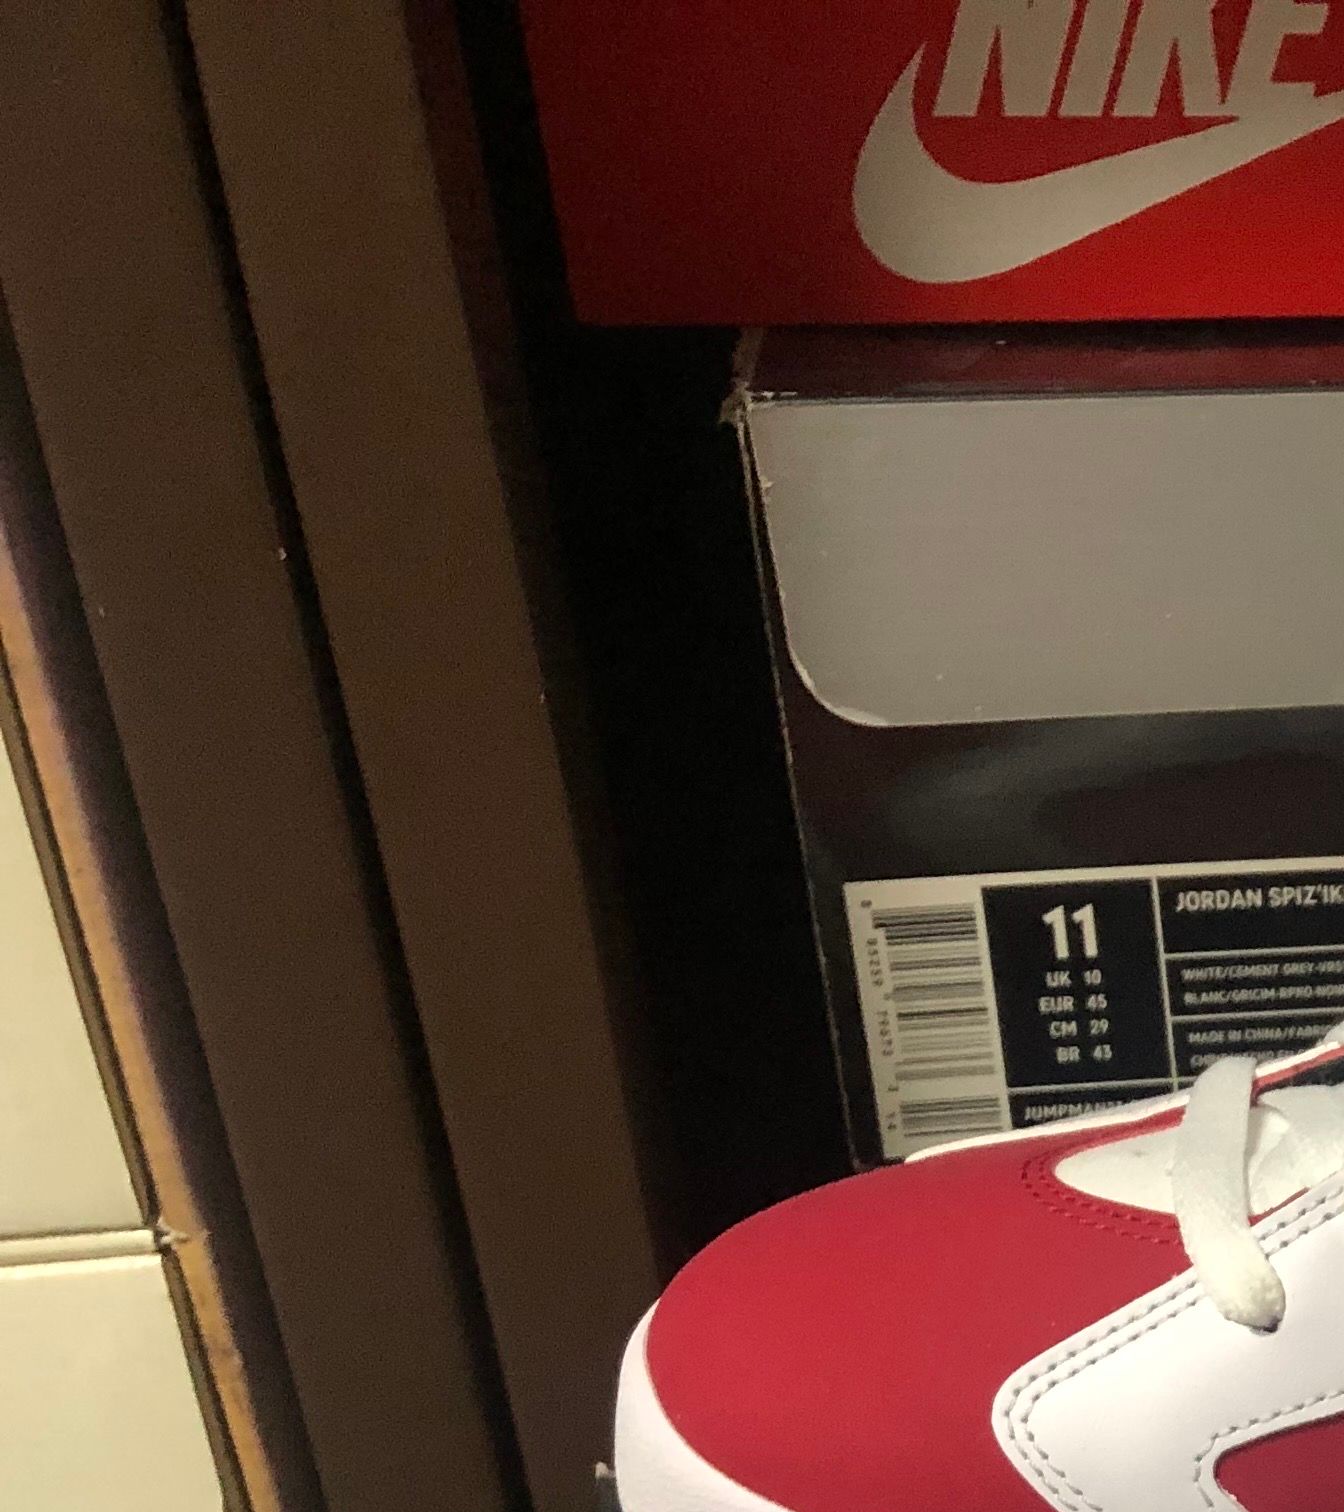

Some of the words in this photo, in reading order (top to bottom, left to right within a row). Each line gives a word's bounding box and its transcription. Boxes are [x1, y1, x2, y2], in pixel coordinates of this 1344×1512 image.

[1177, 890, 1262, 912] JORDAN
[1042, 903, 1099, 960] 11
[1045, 970, 1072, 988] UK
[1083, 968, 1102, 986] 10
[1038, 995, 1075, 1015] EUR
[1086, 993, 1108, 1012] 45
[1049, 1020, 1078, 1039] CM
[1089, 1018, 1109, 1036] 29
[1188, 1030, 1225, 1044] MADE
[1227, 1029, 1242, 1042] IN
[1056, 1045, 1081, 1064] BR
[1093, 1044, 1113, 1062] 43
